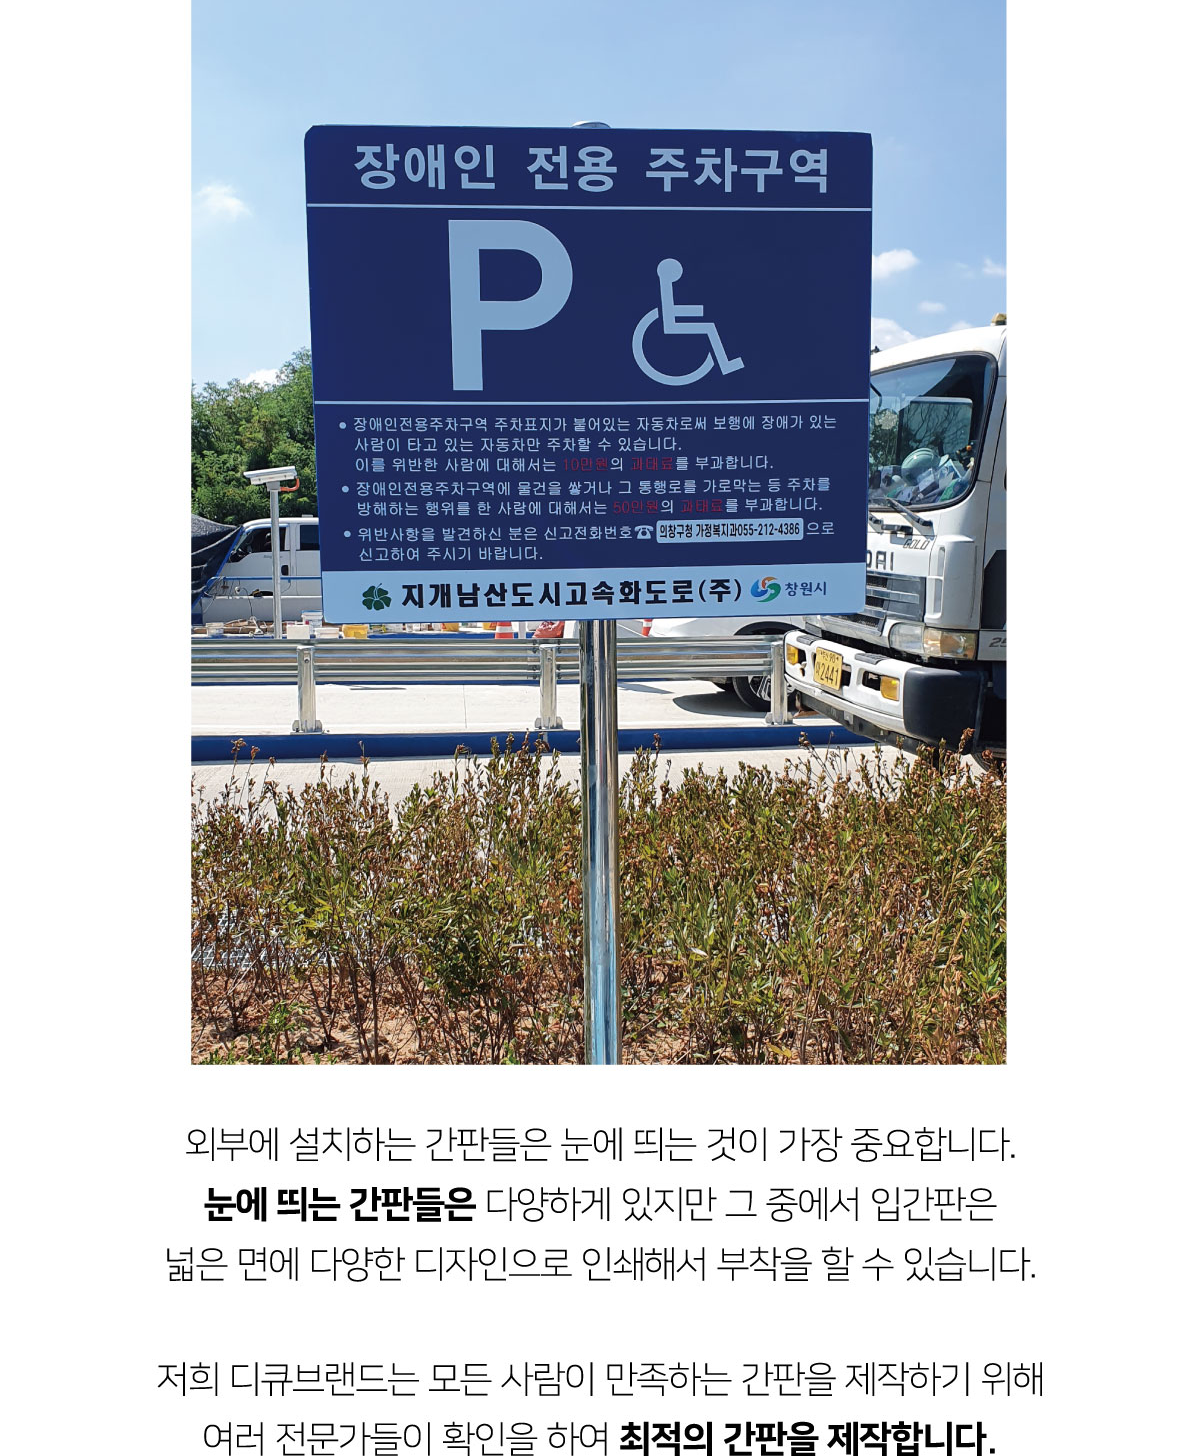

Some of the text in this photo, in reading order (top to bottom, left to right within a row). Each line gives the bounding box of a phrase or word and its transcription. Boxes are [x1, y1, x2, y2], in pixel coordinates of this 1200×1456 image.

[354, 143, 829, 193] 장애인 전용 주차구역
[448, 219, 573, 391] P
[353, 414, 837, 432] 장애인전용주차구역 주차표지가 붙어있는 자동차로써 보행에 장애가 있는
[354, 437, 682, 452] 사람이 타고 있는 자동차만 주차할 수 있습니다.
[355, 455, 774, 473] 이를 위반한 사람에 대해서는 10만원의 과태료를 부과합니다.
[356, 477, 831, 496] 장애인전용주차구역에 물건을 쌓거나 그 통행로를 가로막는 등 주차를
[357, 497, 823, 516] 방해하는 행위를 한 사람에 대해서는 50만원의 과태료를 부과합니다.
[357, 527, 435, 542] 위반사항을
[442, 527, 502, 542] 발견하신
[508, 526, 538, 541] 분은
[543, 525, 633, 541] 신고전화번호
[659, 523, 693, 539] 의창구청
[806, 521, 835, 536] 으로
[358, 546, 543, 562] 신고하여 주시기 바랍니다.
[401, 578, 742, 610] 지개남산도시고속화도로(주)
[784, 580, 828, 597] 창원시
